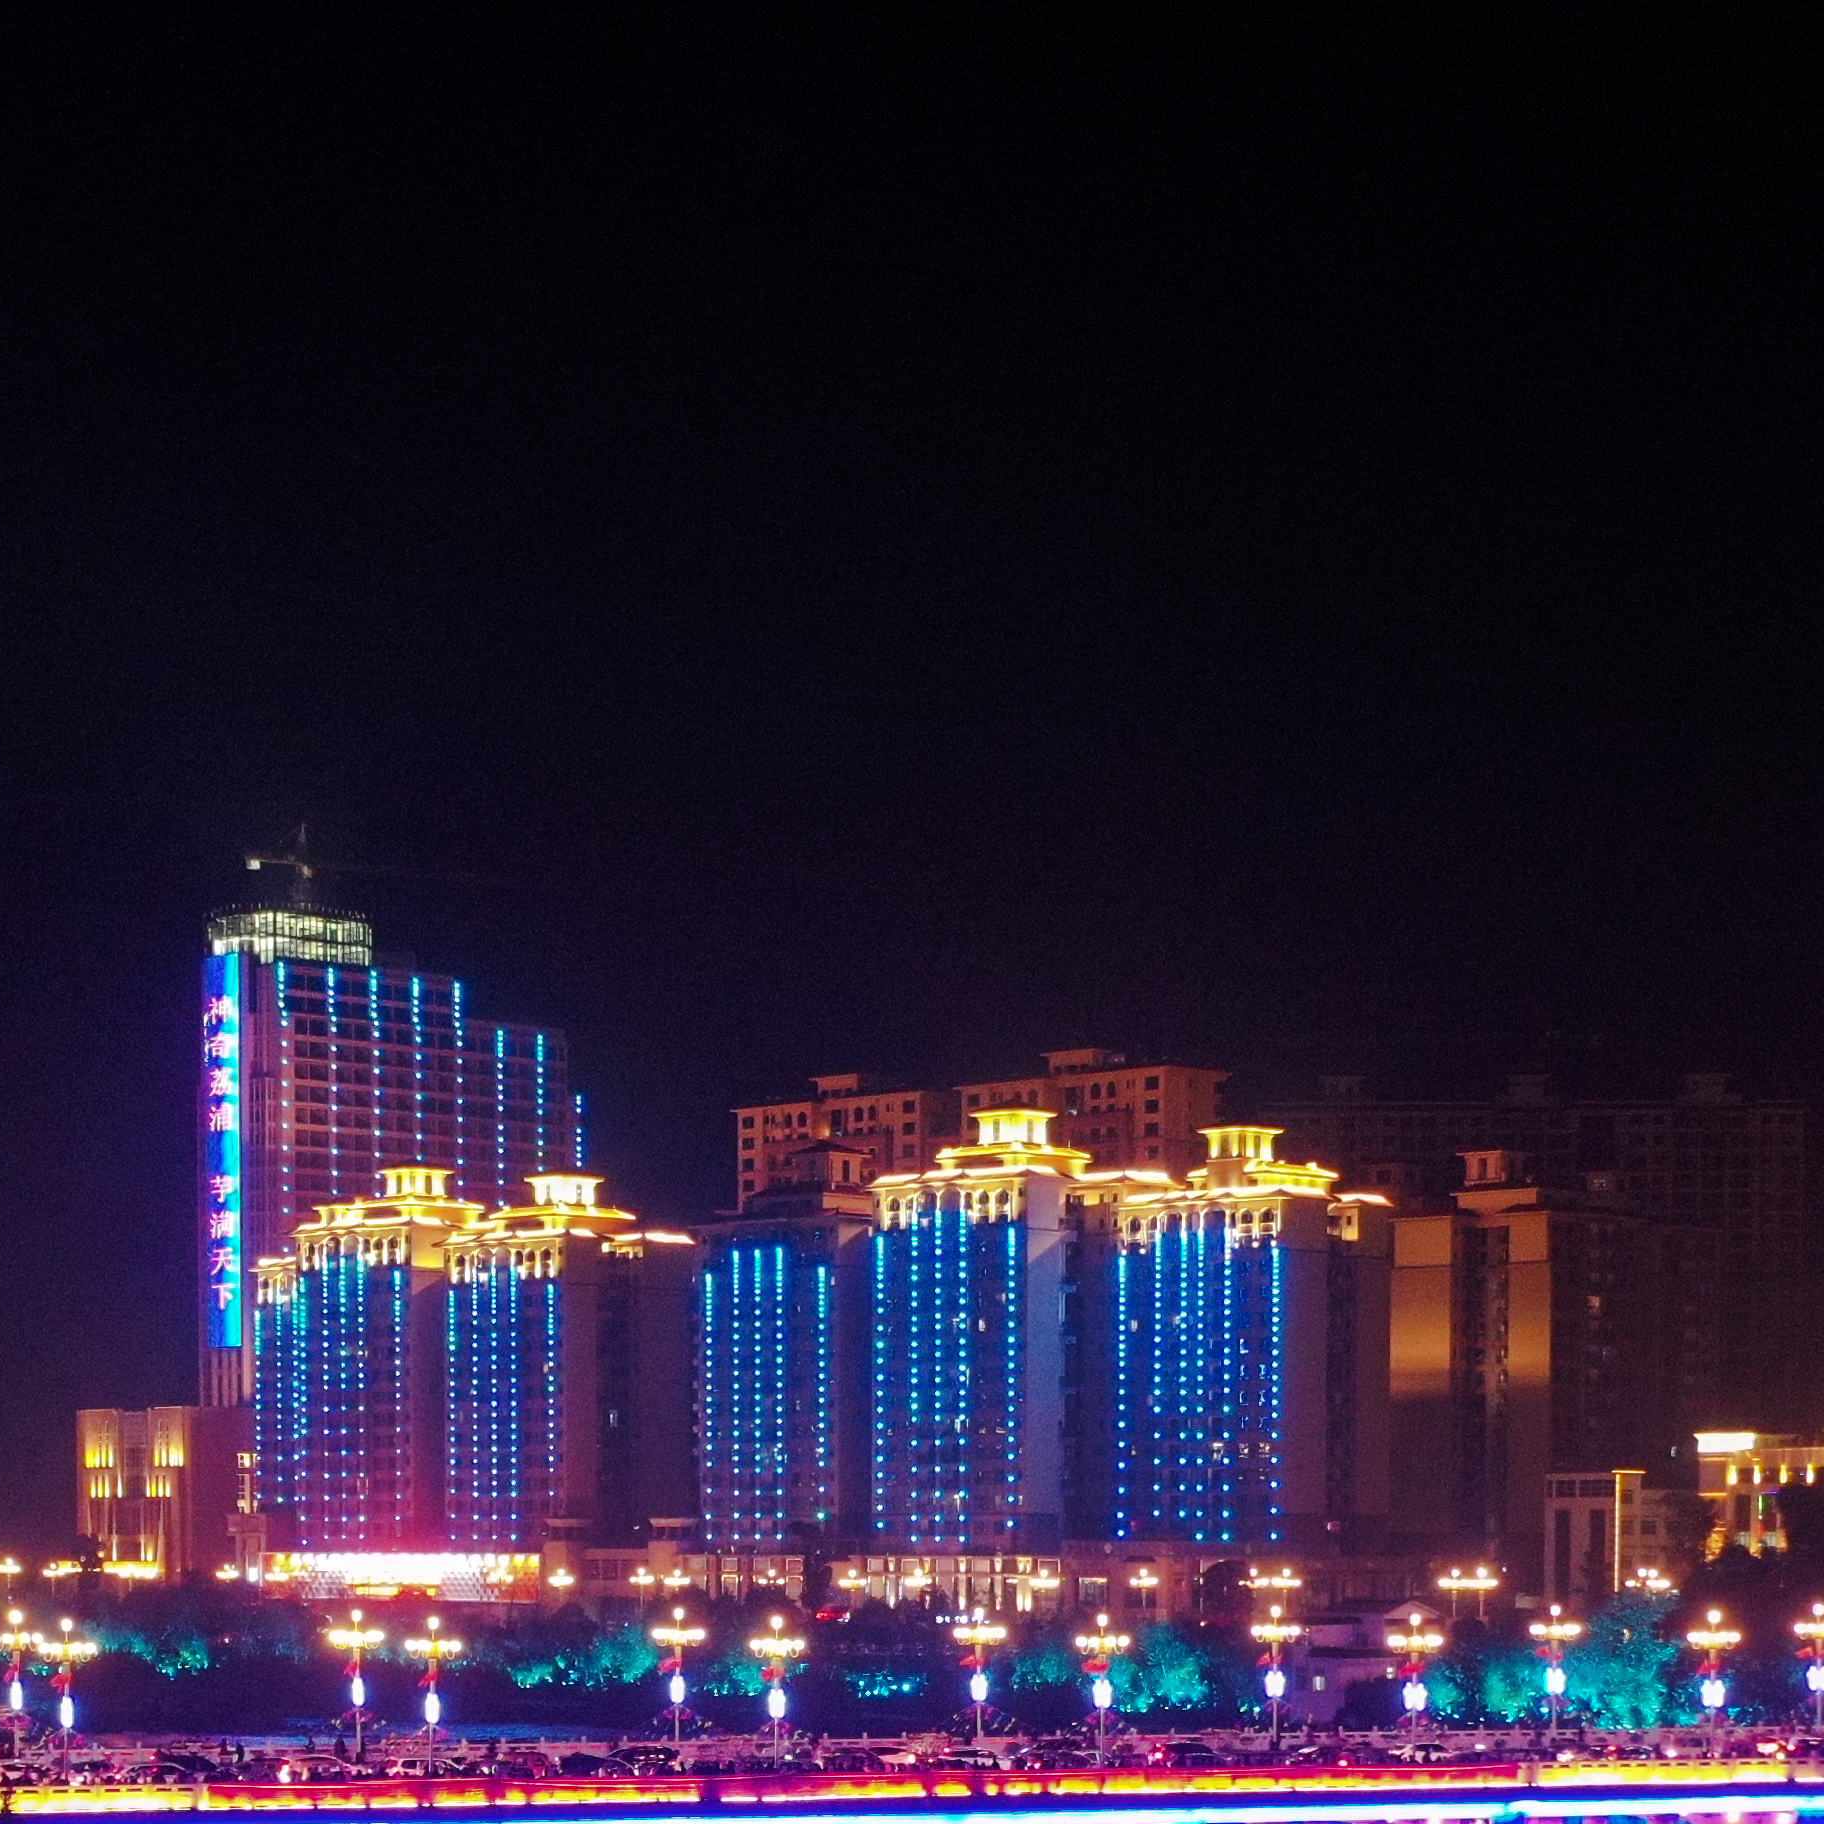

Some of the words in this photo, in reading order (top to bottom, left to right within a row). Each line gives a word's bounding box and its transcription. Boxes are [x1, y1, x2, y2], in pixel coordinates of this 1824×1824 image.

[209, 995, 234, 1132] 神奇荔浦
[209, 1175, 235, 1310] 芋满天下
